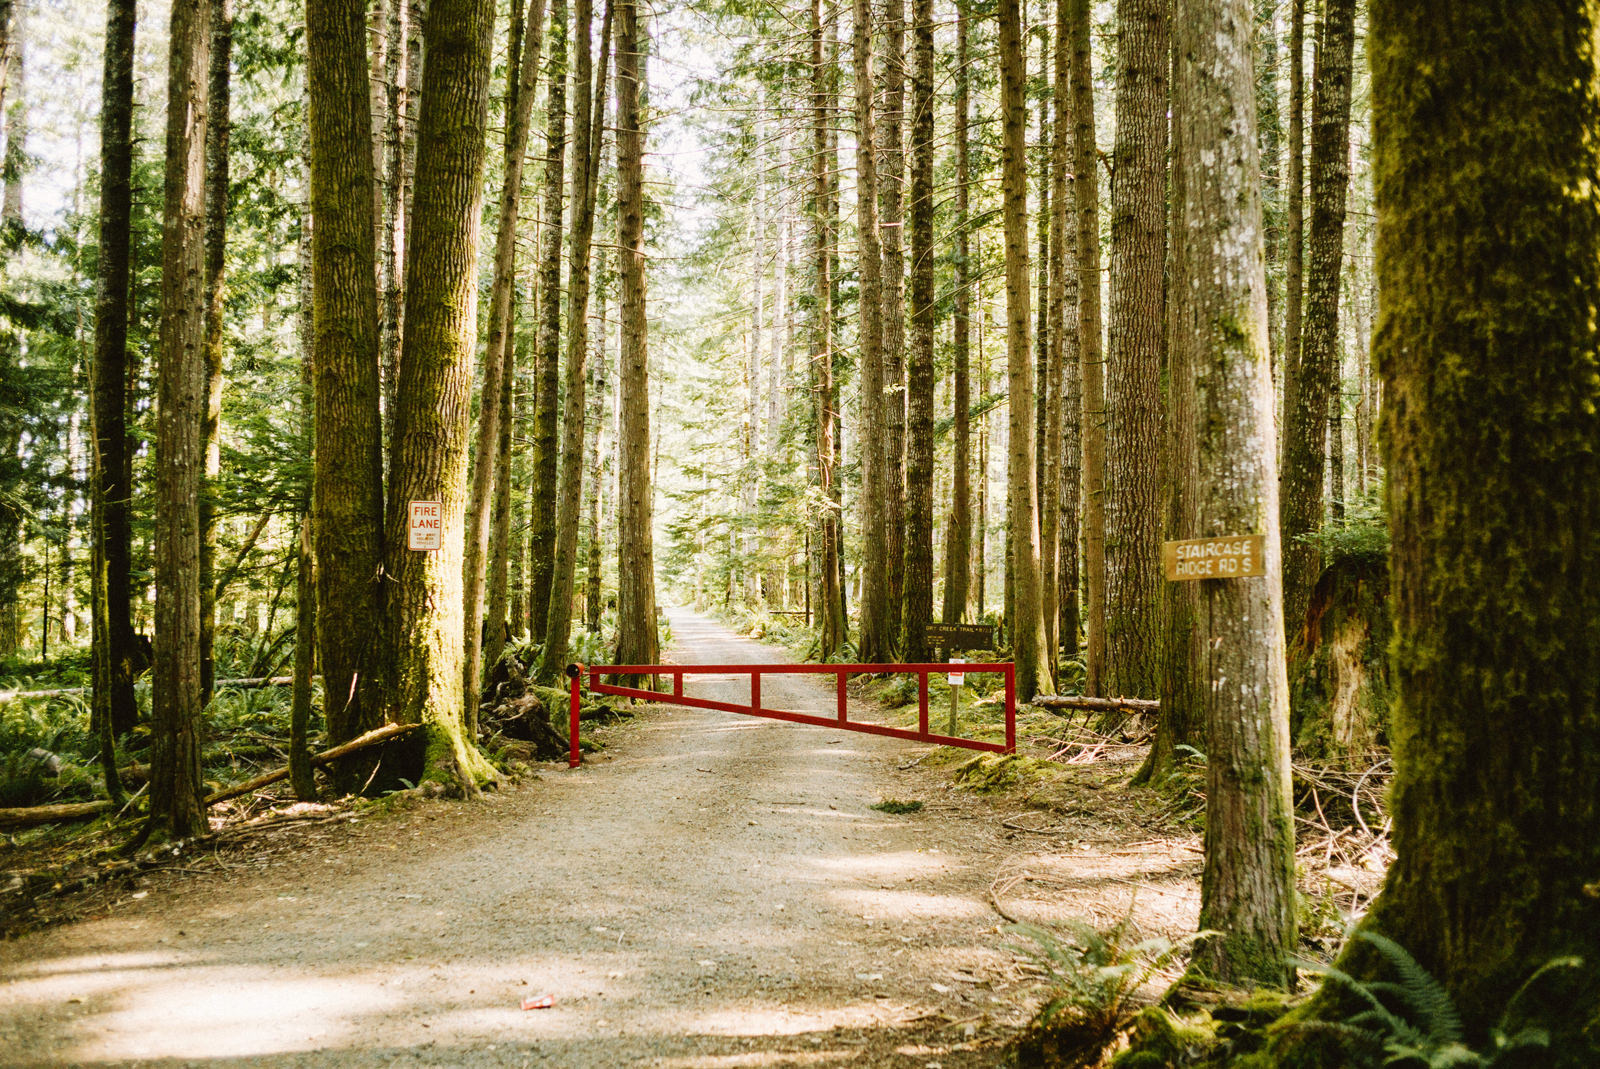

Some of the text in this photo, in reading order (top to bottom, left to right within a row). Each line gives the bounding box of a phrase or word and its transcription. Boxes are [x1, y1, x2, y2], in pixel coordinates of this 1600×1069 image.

[414, 506, 437, 516] FIRE
[412, 519, 440, 529] LANE
[1176, 540, 1252, 559] STAIRCASE
[1176, 557, 1252, 575] RIDGE RD S
